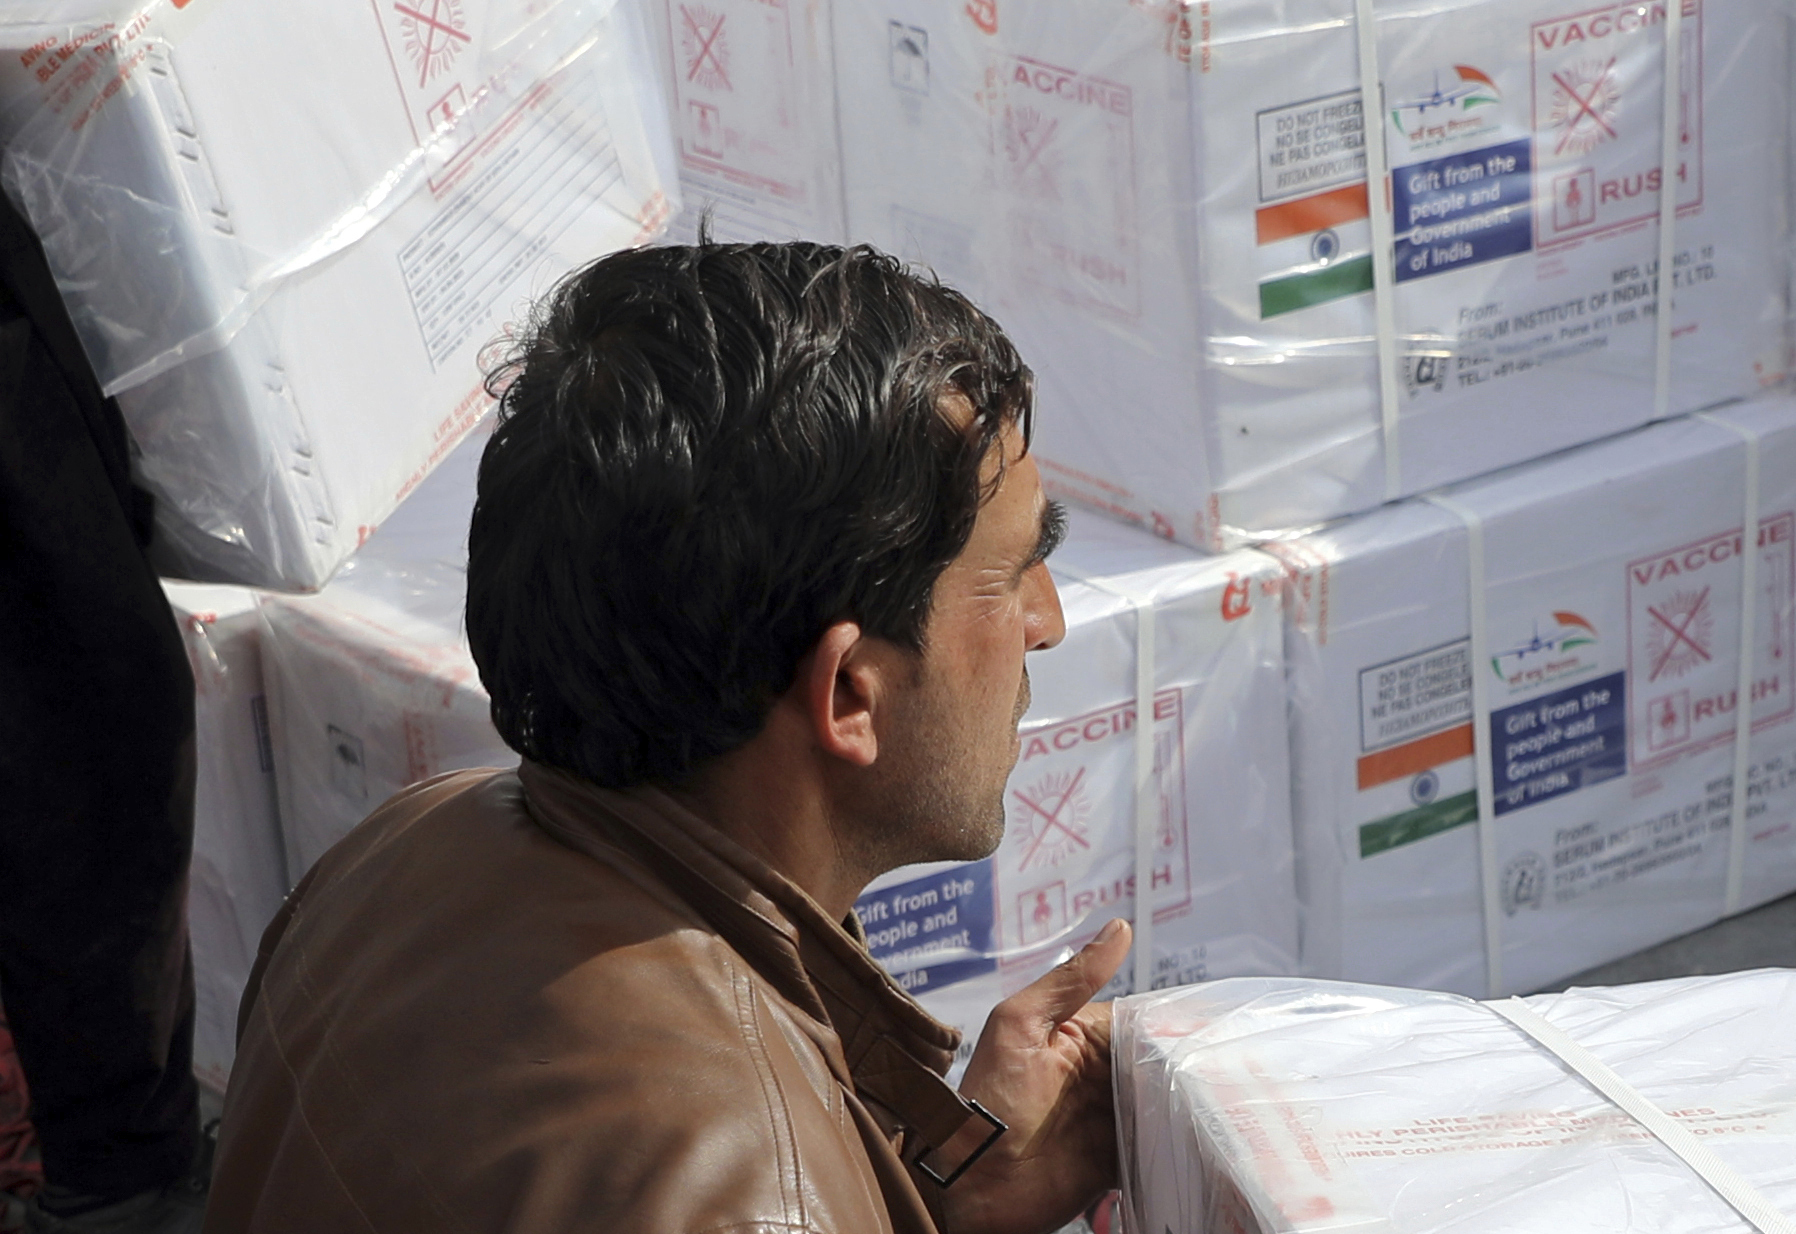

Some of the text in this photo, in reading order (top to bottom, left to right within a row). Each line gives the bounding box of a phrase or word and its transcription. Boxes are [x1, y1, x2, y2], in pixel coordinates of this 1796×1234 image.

[1014, 65, 1132, 118] ACCINE
[1409, 154, 1516, 195] Gift from the
[1409, 182, 1500, 225] people and
[1409, 210, 1511, 246] Government
[1410, 242, 1473, 271] of India
[1513, 300, 1585, 332] INSTITUTE
[1590, 292, 1608, 312] OF
[1612, 281, 1648, 305] INDIA
[1505, 689, 1610, 736] Gift from the
[1694, 675, 1779, 722] RUH
[1023, 697, 1178, 762] ACCINE
[1506, 713, 1595, 761] people and
[1506, 734, 1604, 782] Government
[892, 889, 938, 916] from
[942, 879, 975, 901] the
[868, 905, 958, 949] eople and
